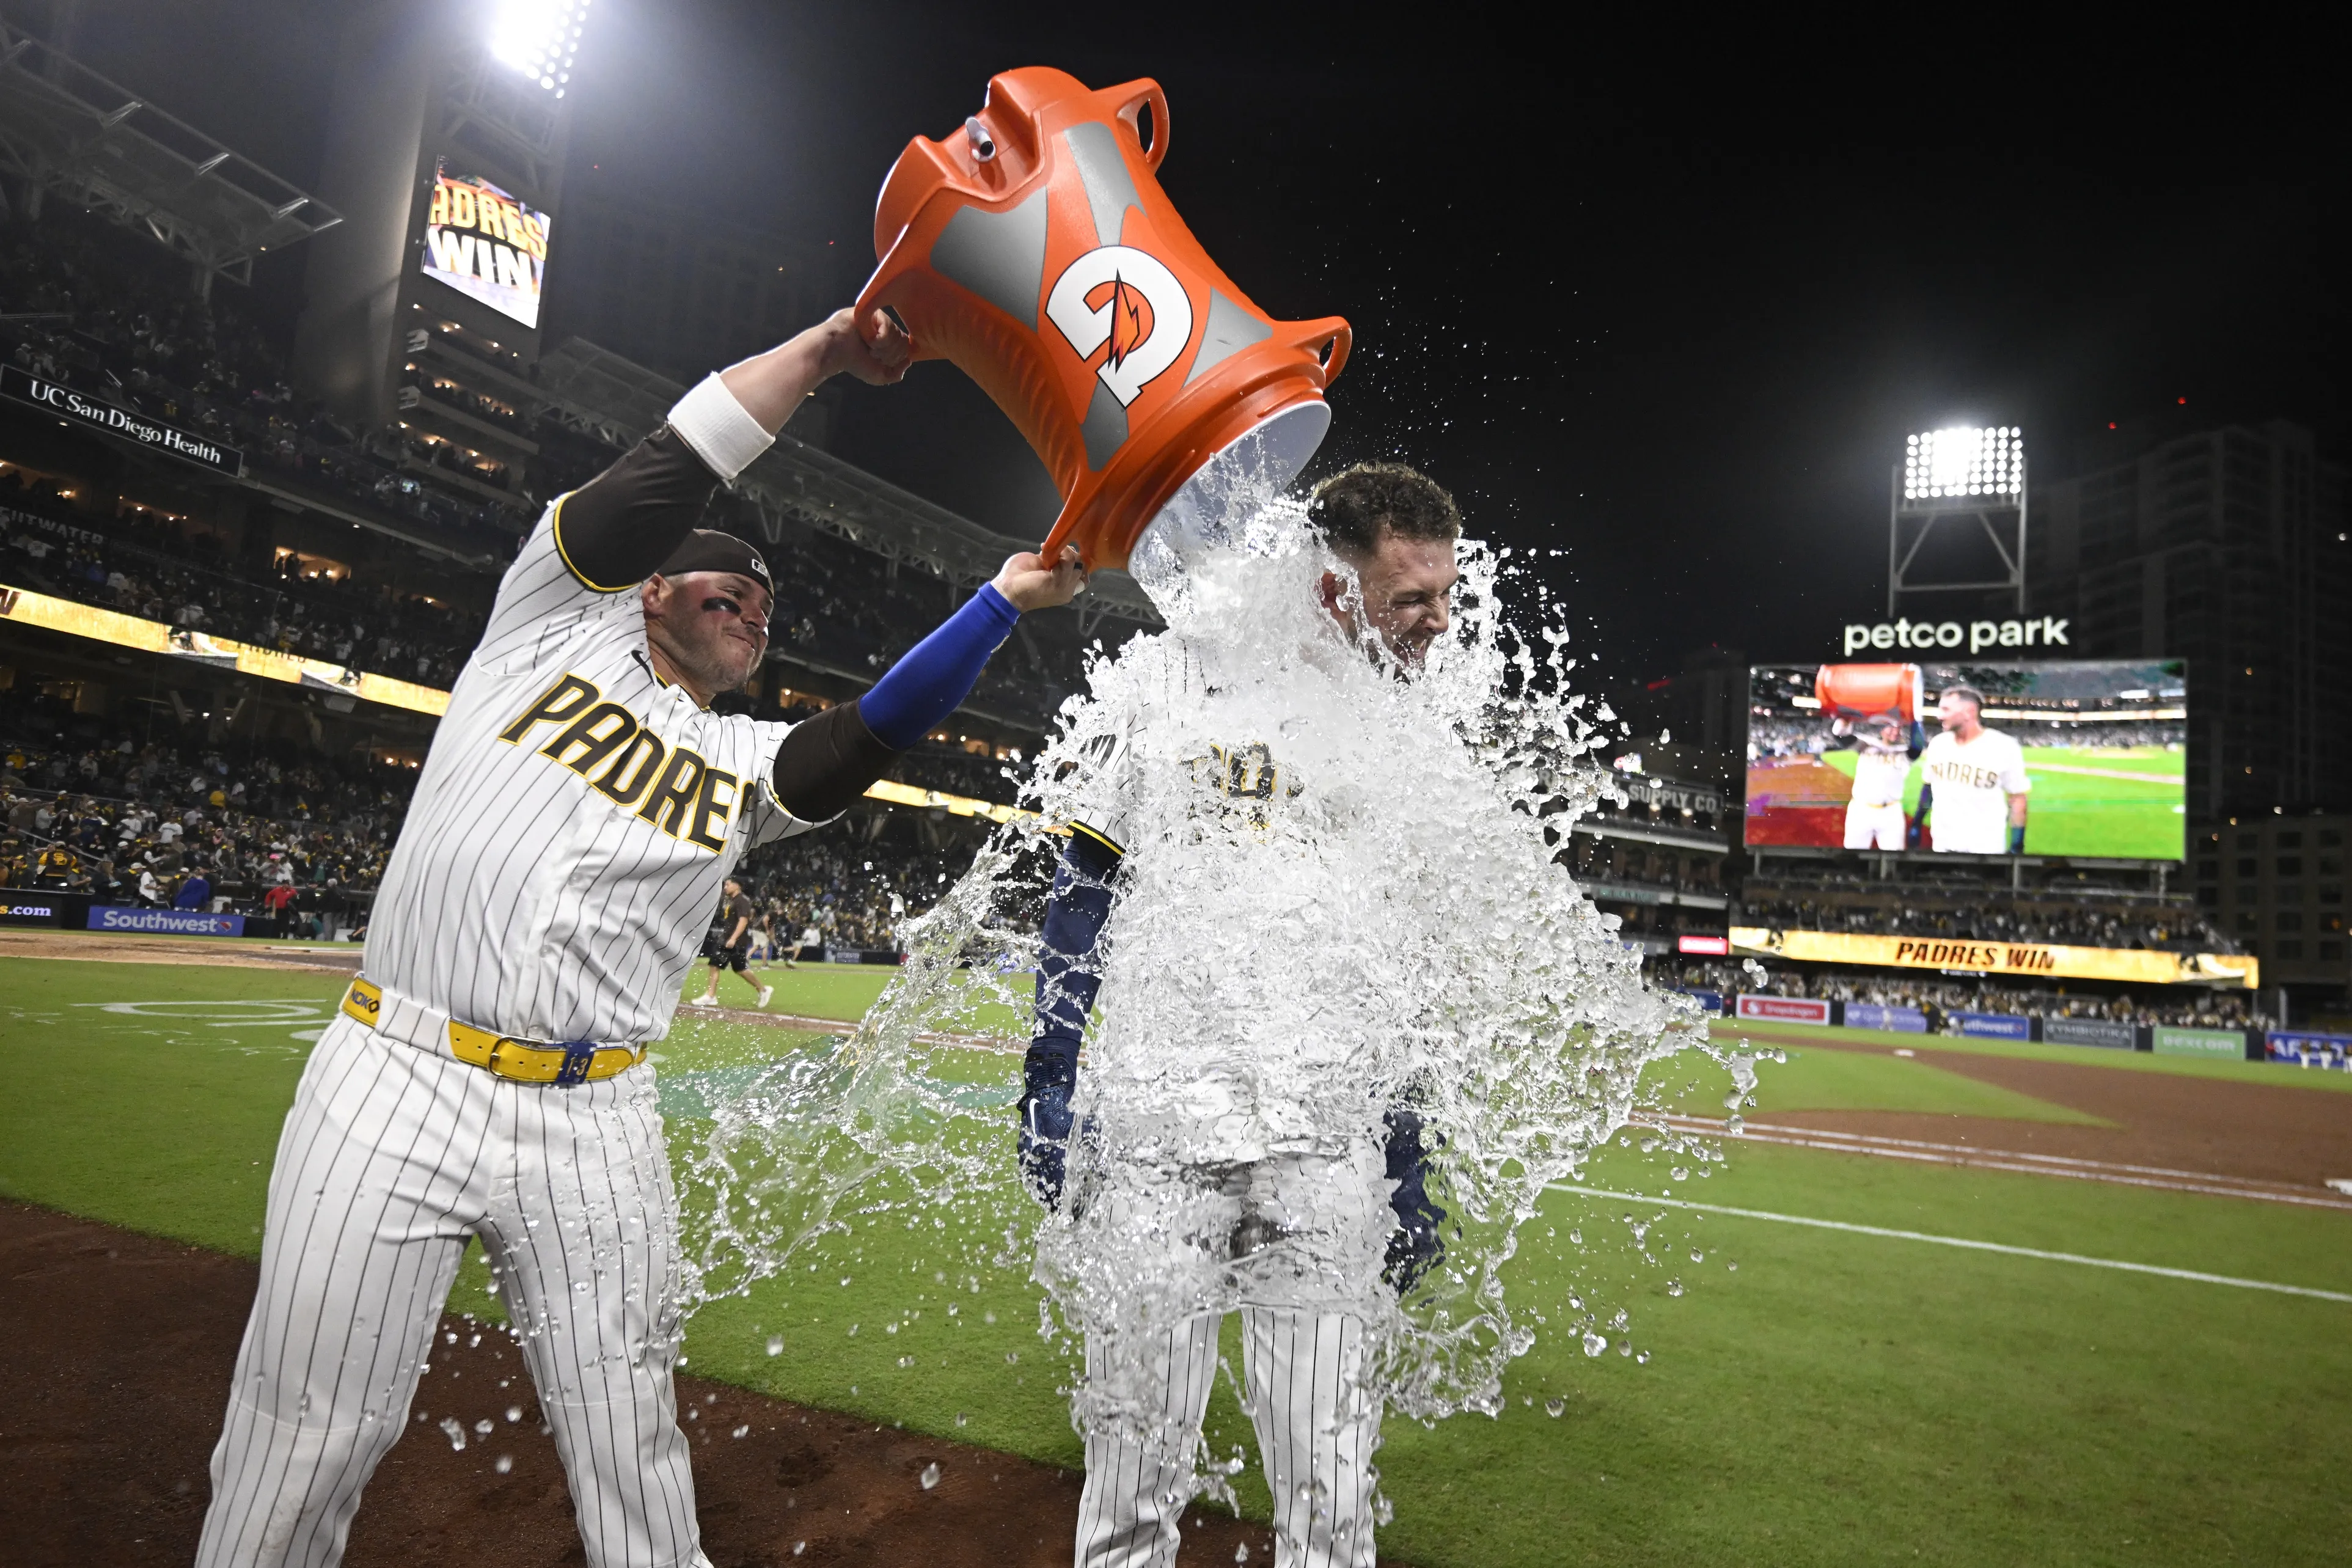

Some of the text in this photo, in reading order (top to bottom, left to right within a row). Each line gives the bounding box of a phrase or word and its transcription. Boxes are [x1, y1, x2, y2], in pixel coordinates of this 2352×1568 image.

[428, 227, 533, 295] WIN
[30, 379, 222, 464] UC San Diego Health
[1844, 615, 2070, 657] petco park
[1628, 784, 1690, 809] SUPPLY
[103, 910, 218, 932] Southwest
[1896, 942, 2056, 969] PADRES WIN
